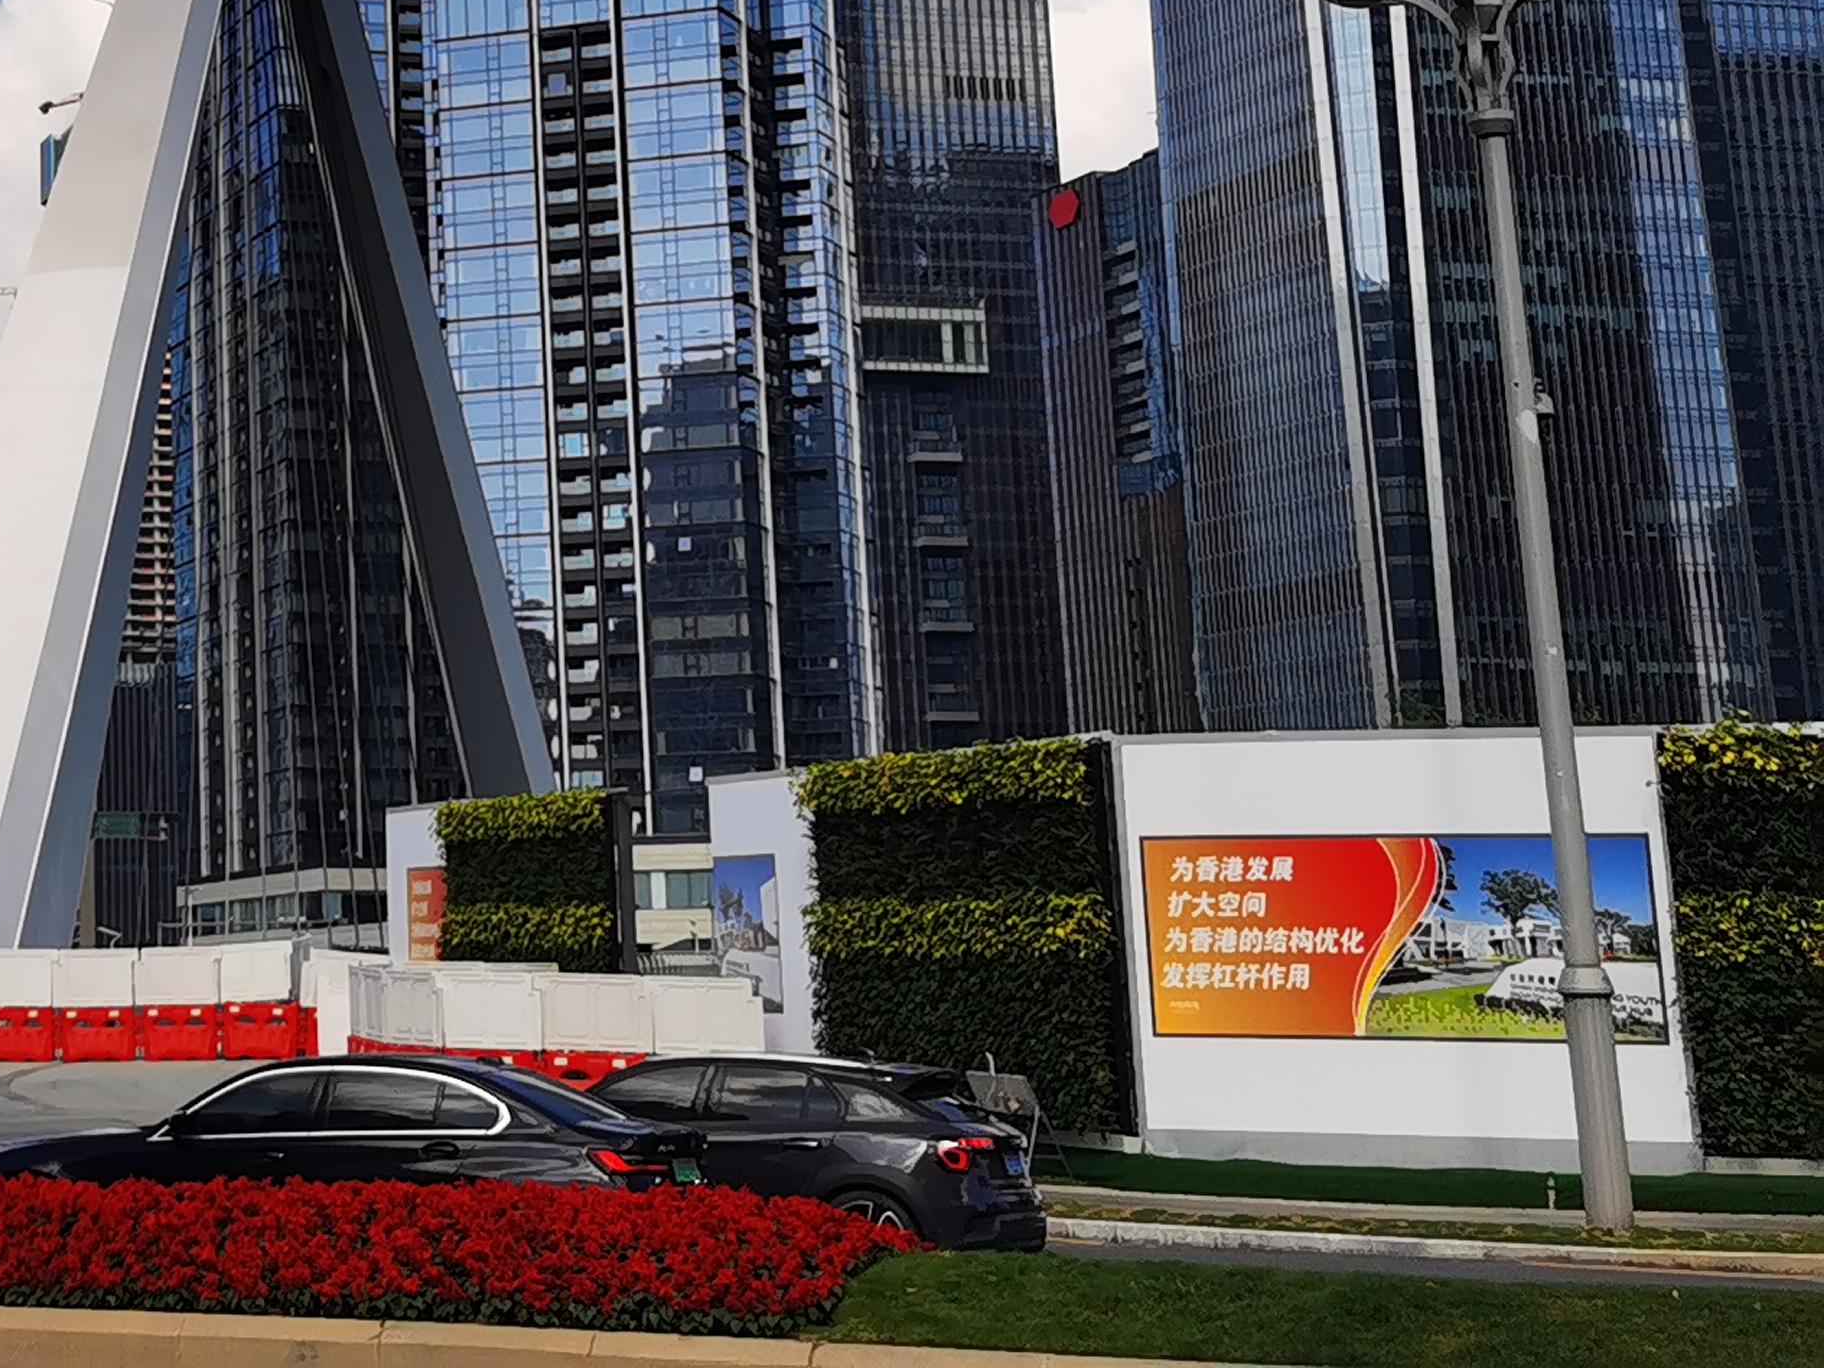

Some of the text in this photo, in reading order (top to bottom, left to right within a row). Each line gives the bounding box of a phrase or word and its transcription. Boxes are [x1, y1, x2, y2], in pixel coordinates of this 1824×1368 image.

[1169, 856, 1294, 882] 为香港发展
[1167, 890, 1267, 917] 扩大空间
[1164, 926, 1365, 954] 为香港的结构优化
[1160, 962, 1311, 990] 发挥杠杆作用
